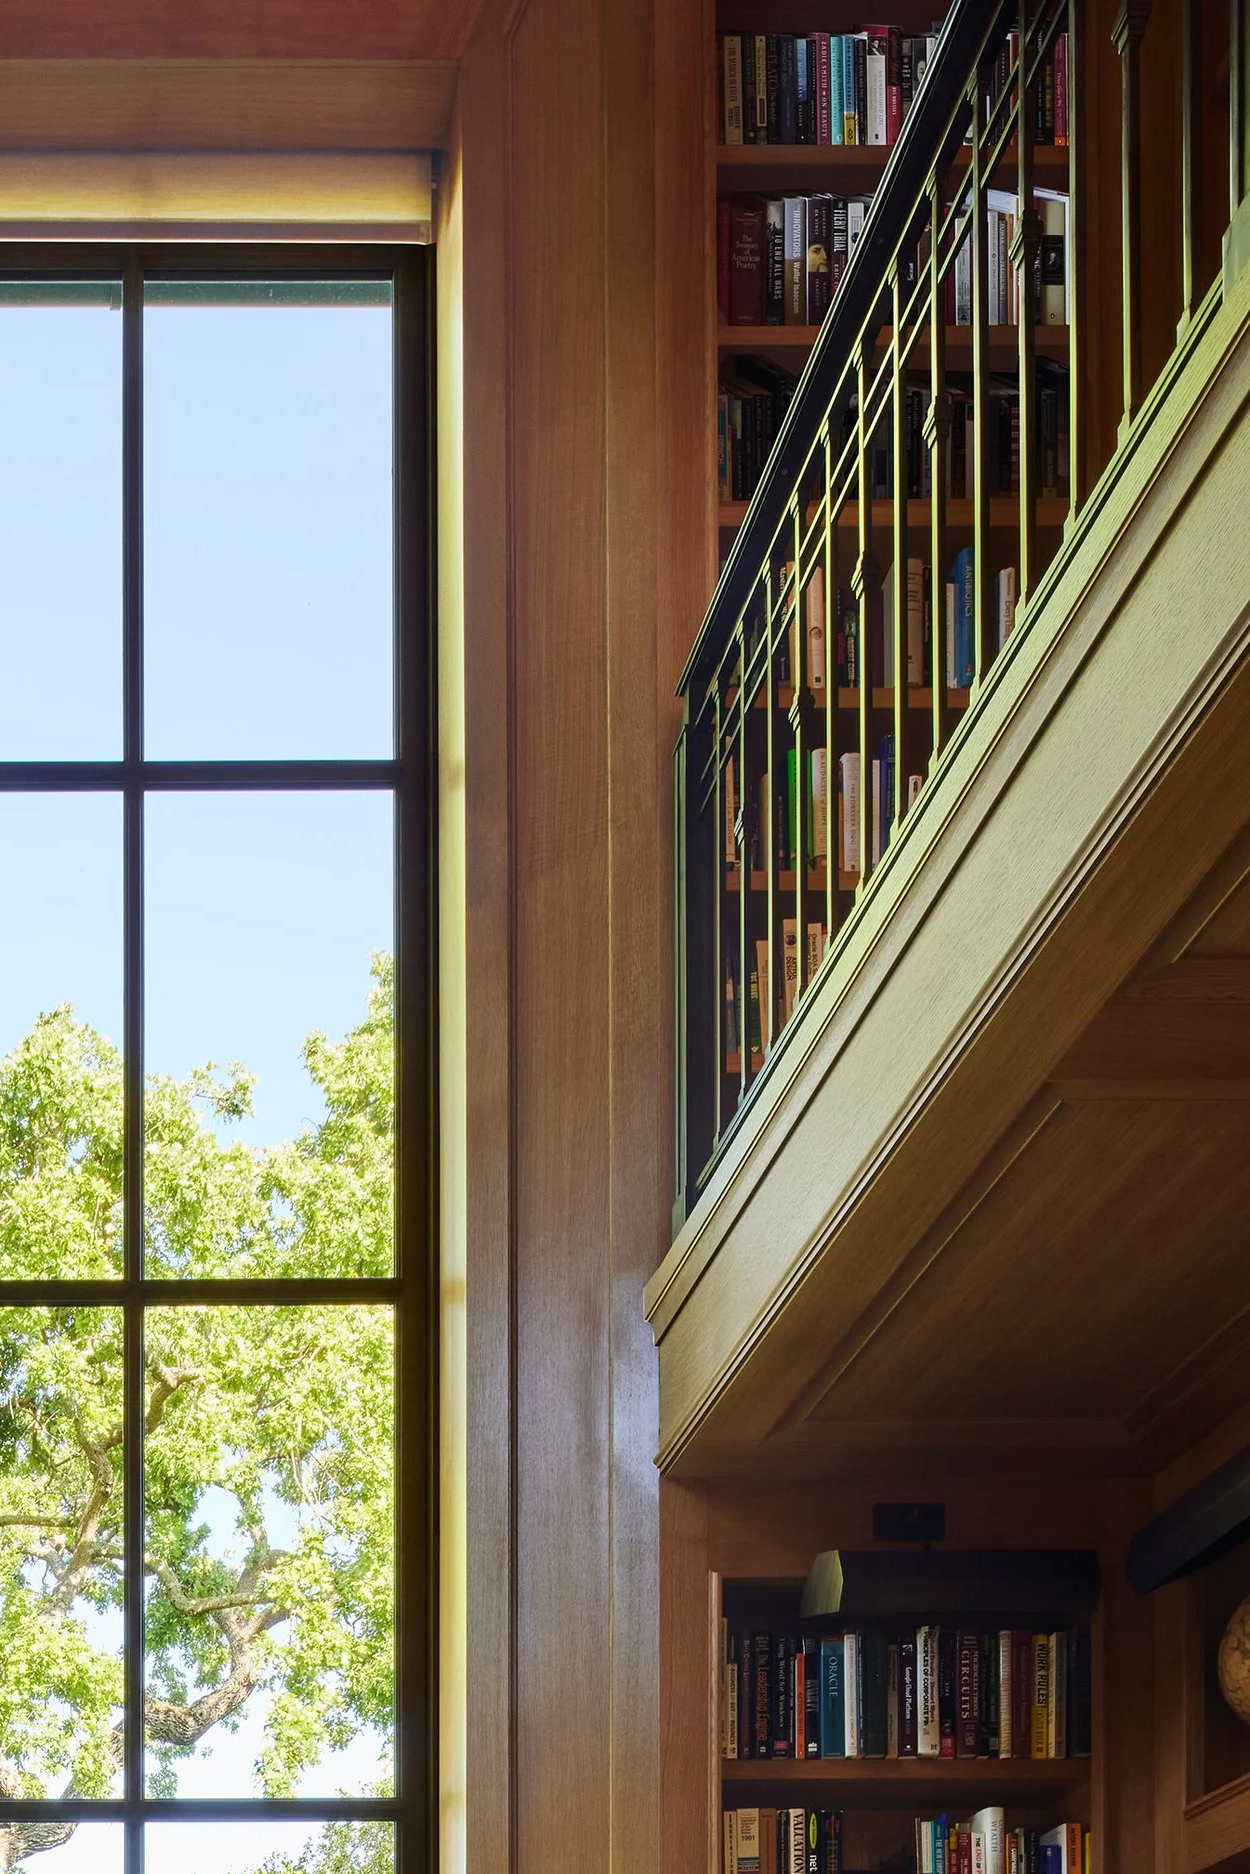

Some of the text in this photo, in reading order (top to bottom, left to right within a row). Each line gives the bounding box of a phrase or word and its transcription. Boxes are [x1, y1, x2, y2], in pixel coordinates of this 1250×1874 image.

[834, 210, 848, 253] FIERY TRIAL
[964, 565, 973, 617] ANTIBIOTICS
[847, 637, 855, 680] INSERT COIN
[757, 1654, 768, 1740] The Leadership Engine
[778, 1638, 786, 1727] Using Word for Windows
[829, 1656, 838, 1696] ORACLE
[961, 1650, 971, 1718] CIRCUITS
[1037, 1642, 1047, 1708] WORK RULES!
[793, 1813, 804, 1873] VALUATION
[808, 1855, 819, 1872] net
